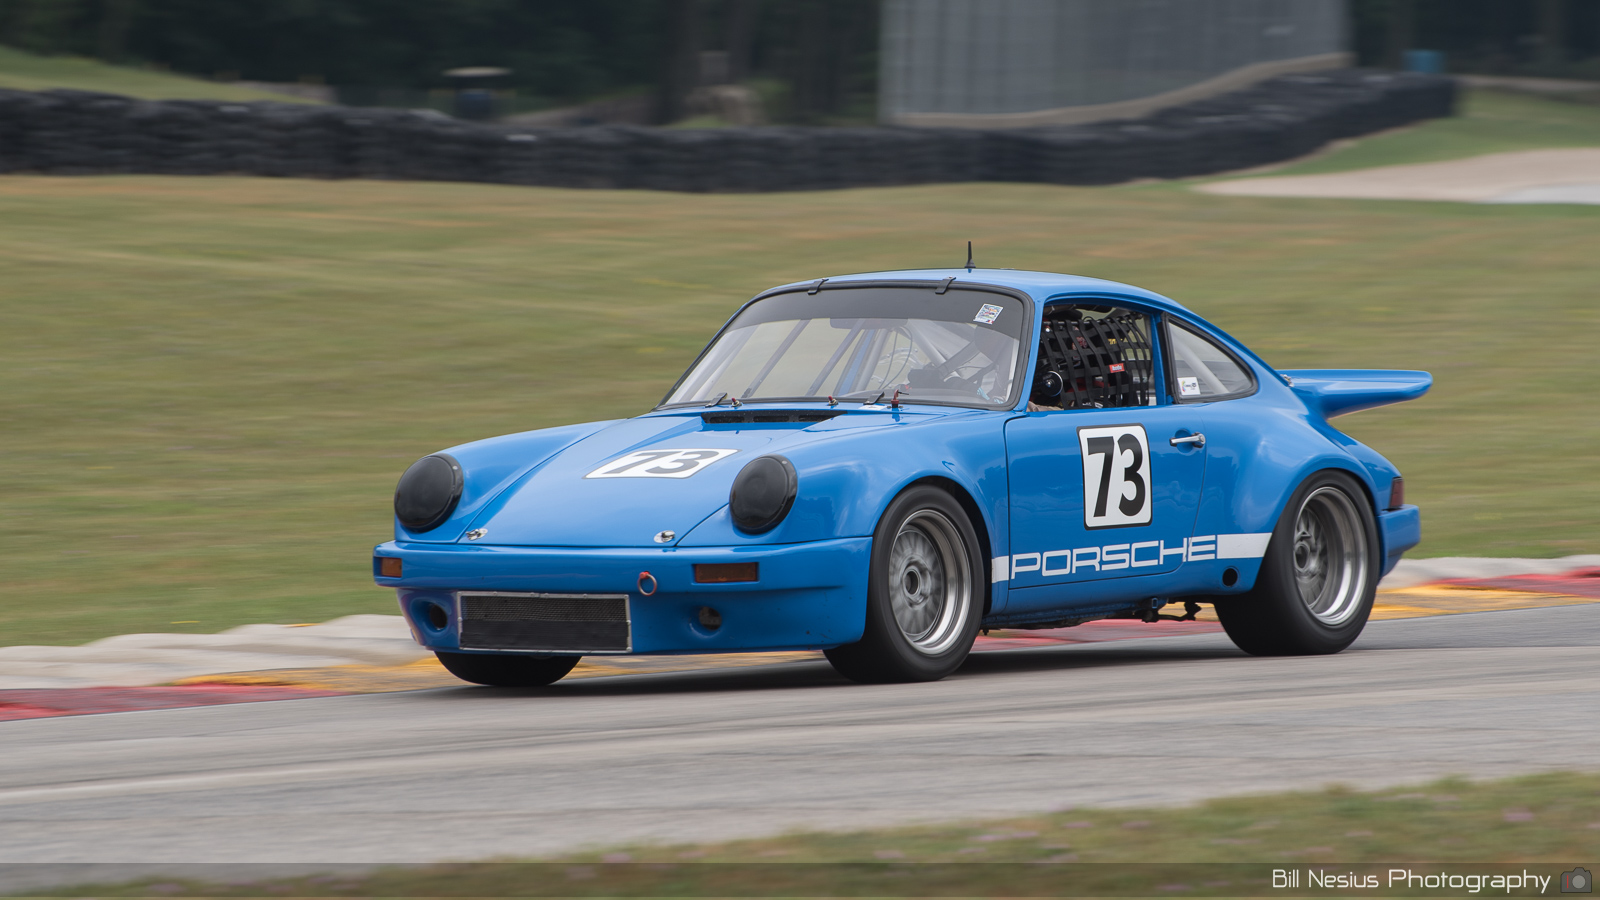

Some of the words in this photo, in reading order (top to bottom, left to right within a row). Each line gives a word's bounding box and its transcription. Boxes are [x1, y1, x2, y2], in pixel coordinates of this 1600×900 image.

[602, 451, 720, 474] 73
[1086, 433, 1146, 517] 73
[1011, 535, 1216, 579] PORSCHE
